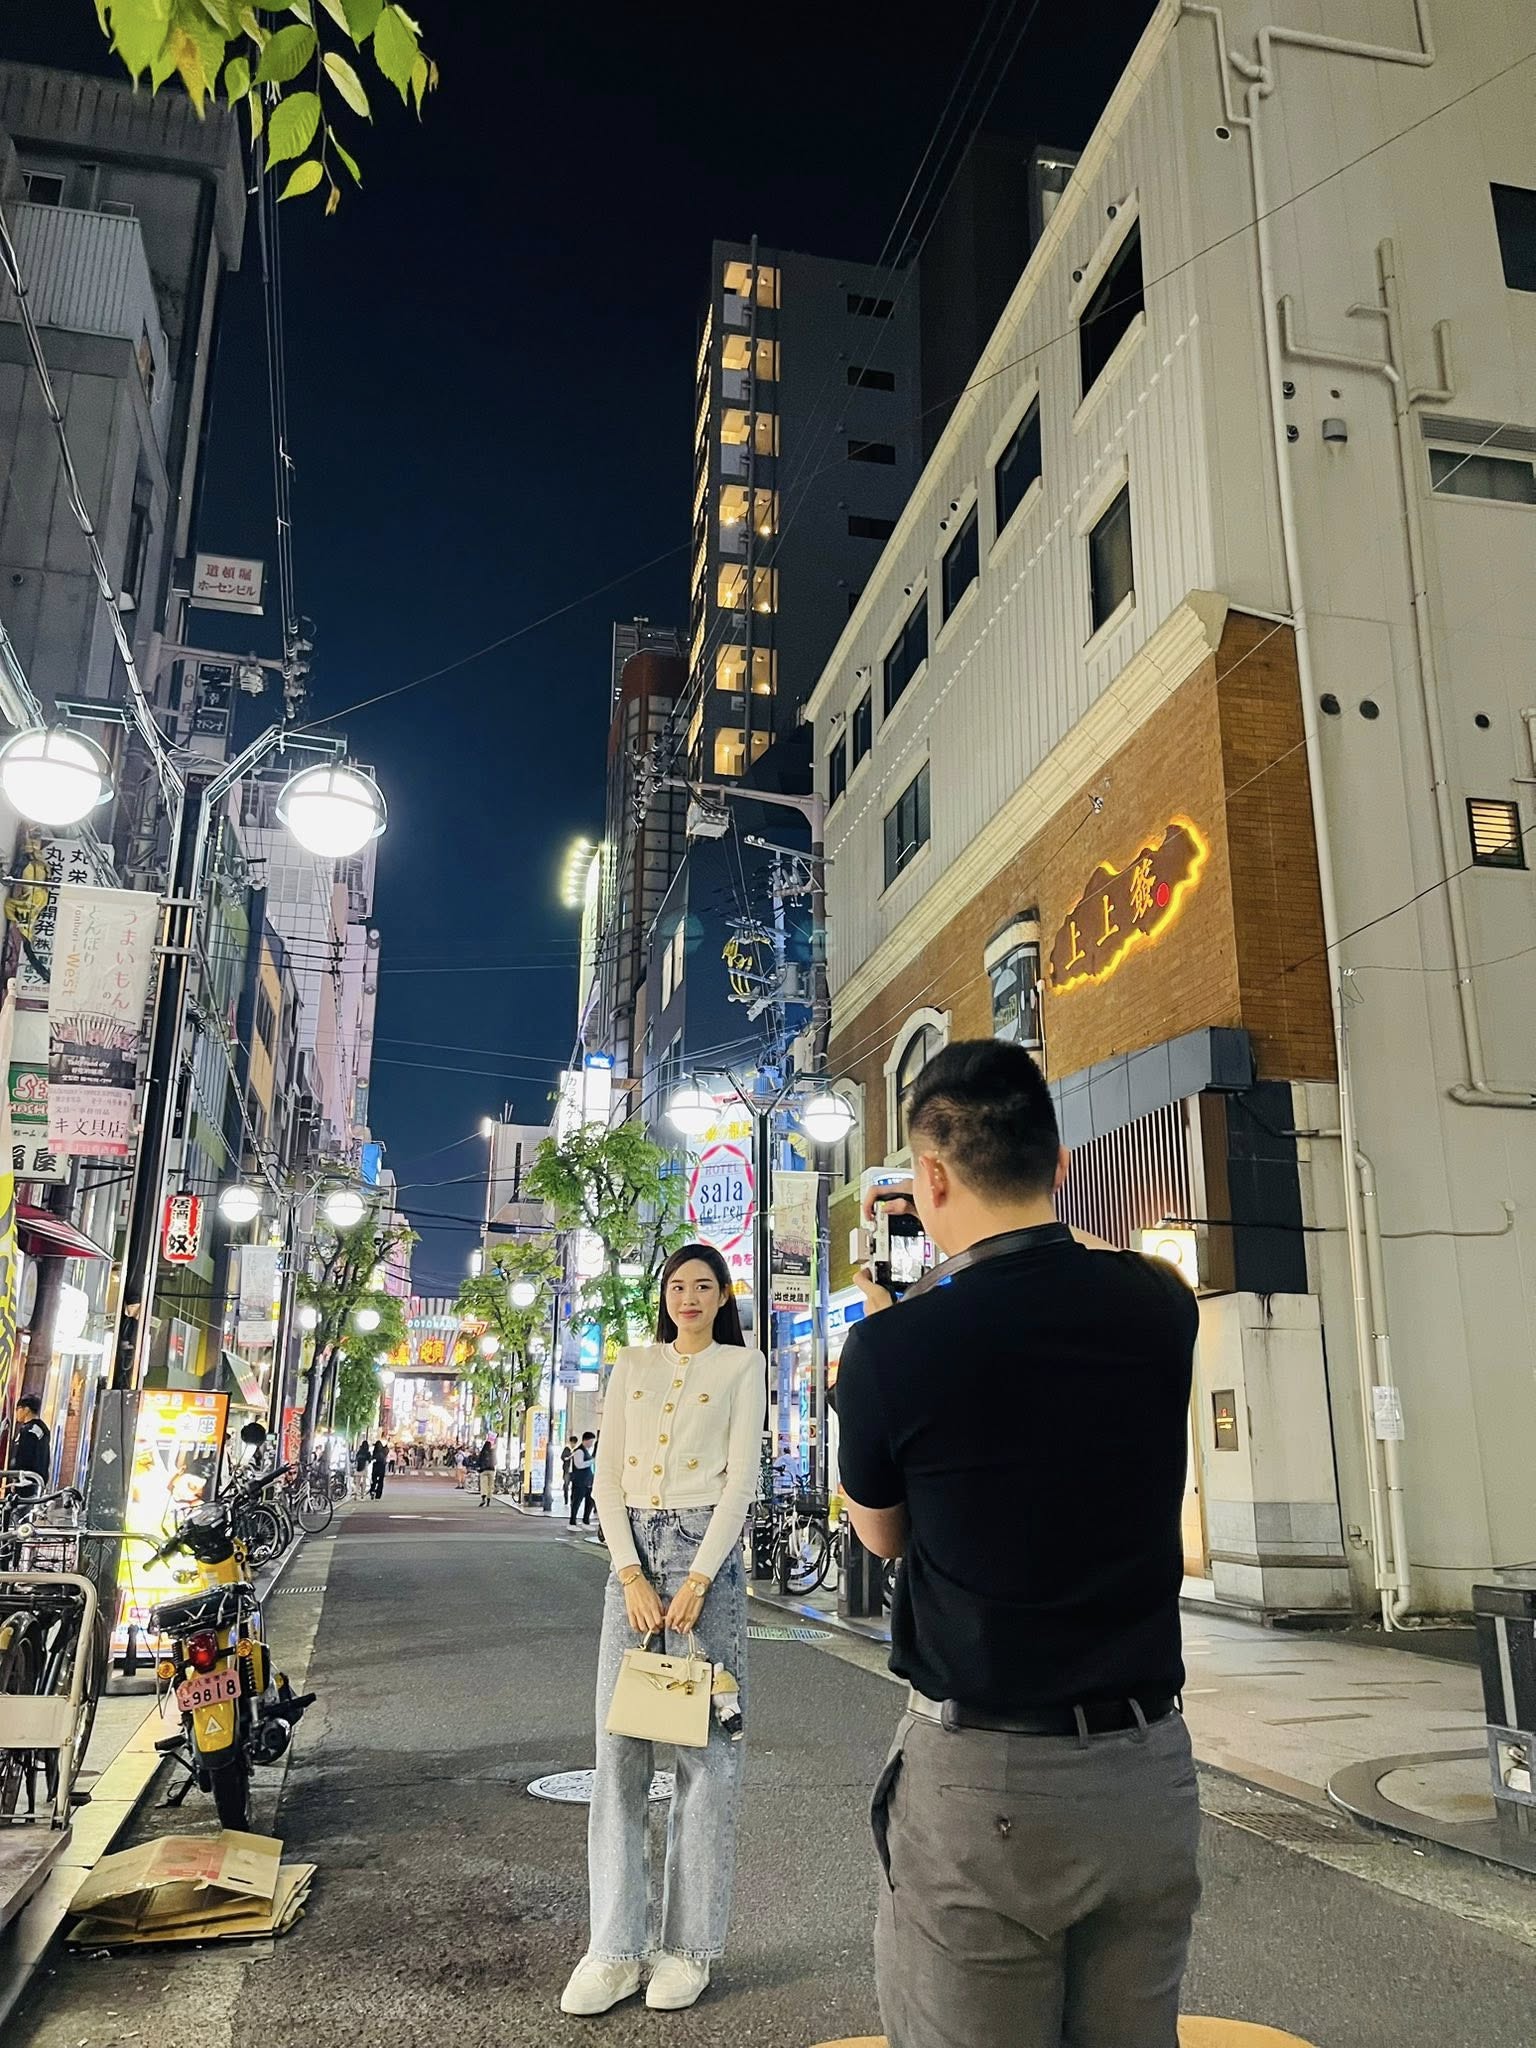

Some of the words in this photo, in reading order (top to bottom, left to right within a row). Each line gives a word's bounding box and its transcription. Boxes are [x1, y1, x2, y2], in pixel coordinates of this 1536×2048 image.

[205, 564, 252, 581] 道頓堀
[198, 580, 256, 597] ホーセンビル
[112, 910, 137, 1010] うまいもん
[705, 1164, 740, 1176] HOTEL
[700, 1176, 743, 1204] sala
[192, 1679, 237, 1706] 9818
